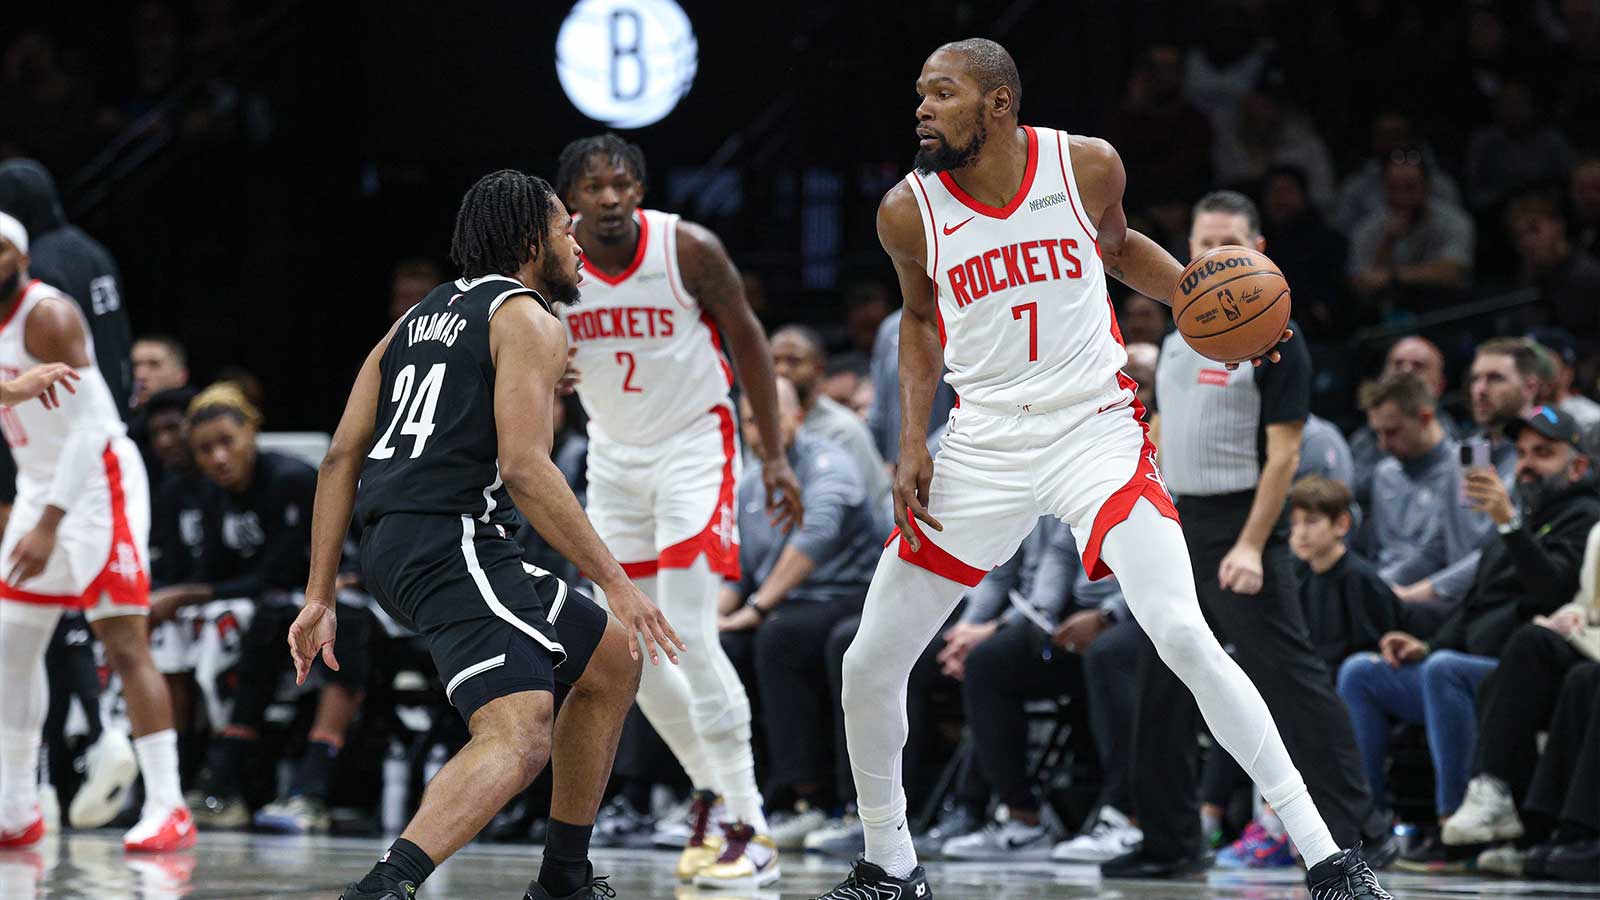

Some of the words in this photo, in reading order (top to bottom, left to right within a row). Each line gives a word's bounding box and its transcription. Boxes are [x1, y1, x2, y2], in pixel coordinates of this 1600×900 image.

[610, 9, 646, 101] B
[1029, 191, 1065, 206] MEMORIAL
[1030, 197, 1067, 212] HERMANN
[947, 238, 1082, 308] ROCKETS
[1179, 256, 1255, 296] Wilson
[407, 311, 467, 348] THOMAS
[567, 307, 674, 342] ROCKETS
[1011, 301, 1038, 363] 7
[615, 351, 644, 393] 2
[368, 362, 447, 461] 24
